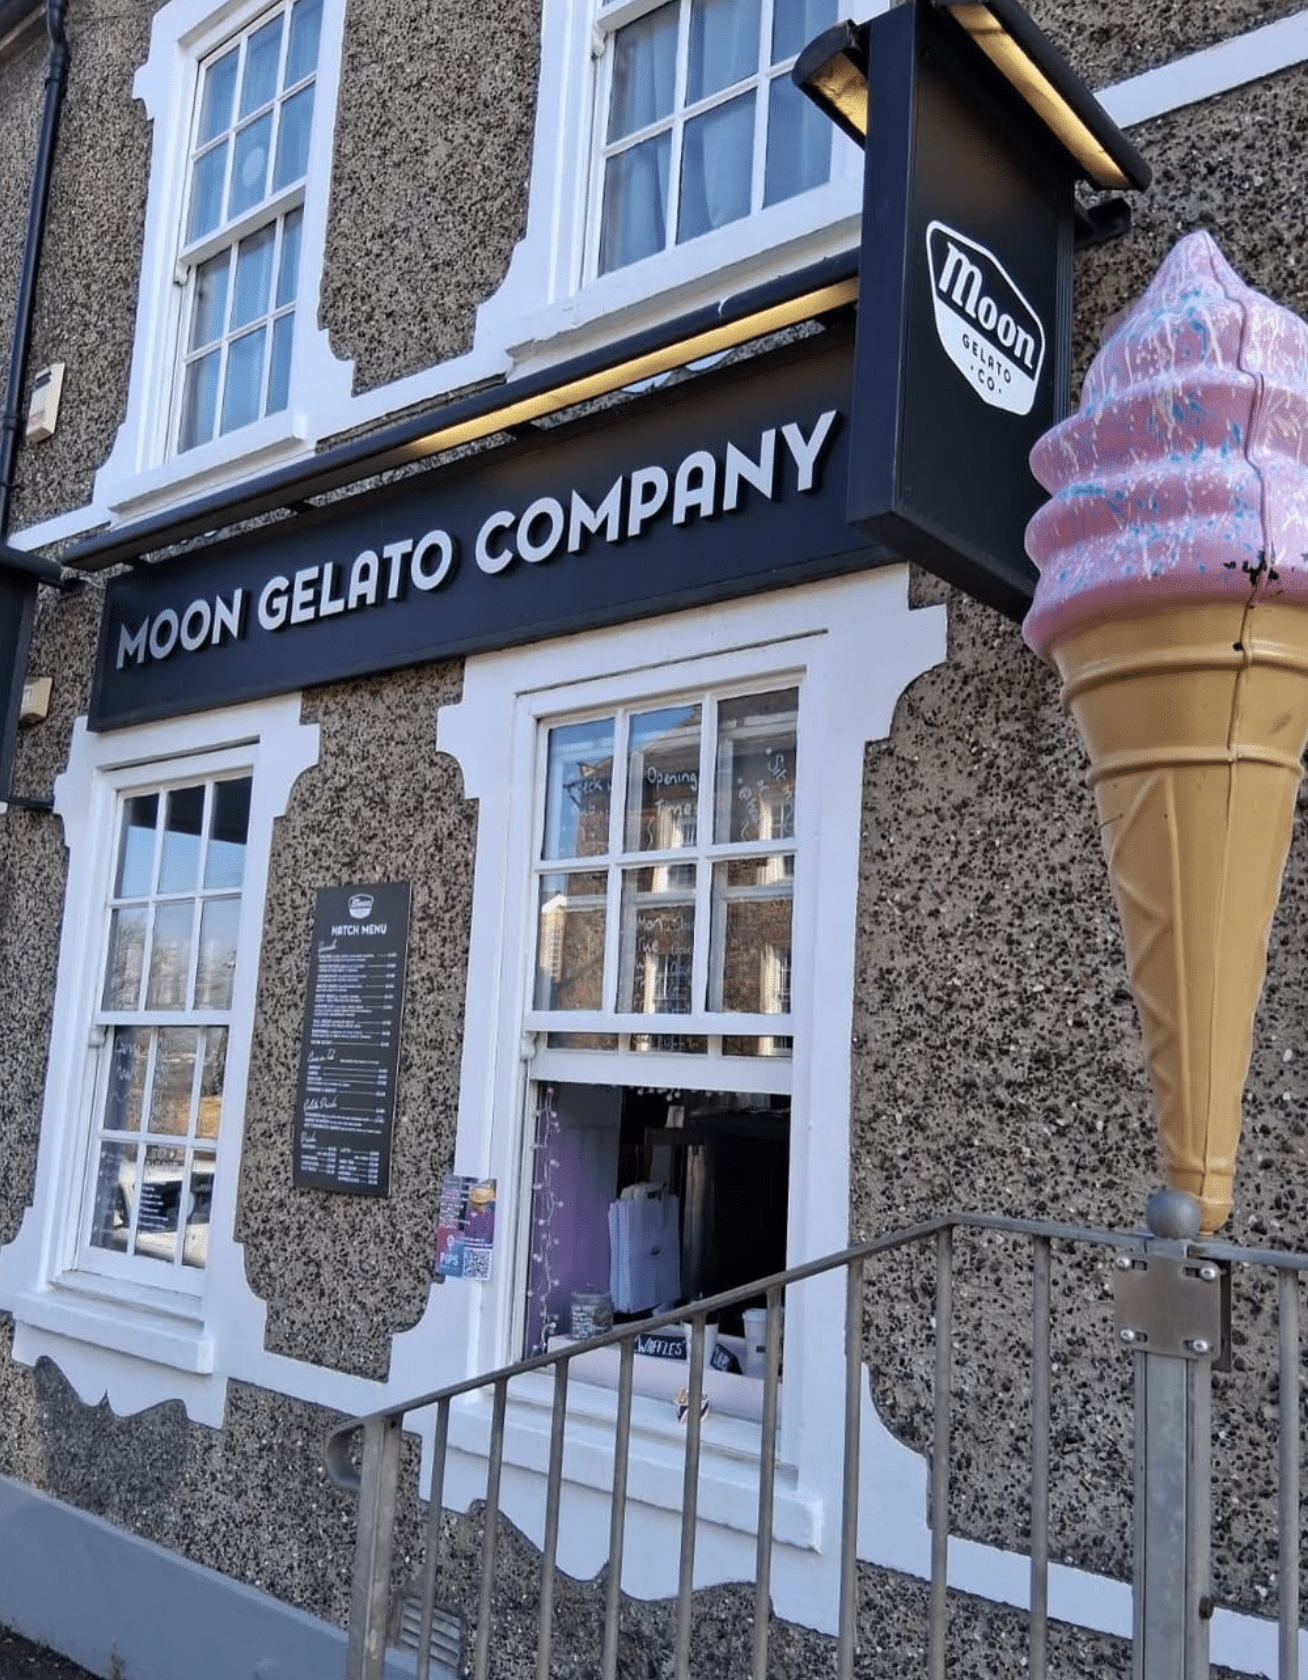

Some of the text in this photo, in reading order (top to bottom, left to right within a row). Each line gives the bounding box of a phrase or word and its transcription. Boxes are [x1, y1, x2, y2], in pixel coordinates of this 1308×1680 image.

[962, 333, 1012, 384] GELATO
[116, 409, 838, 670] MOON GELATO COMPANY
[647, 766, 698, 793] Opening
[331, 923, 388, 936] HATCH MENU
